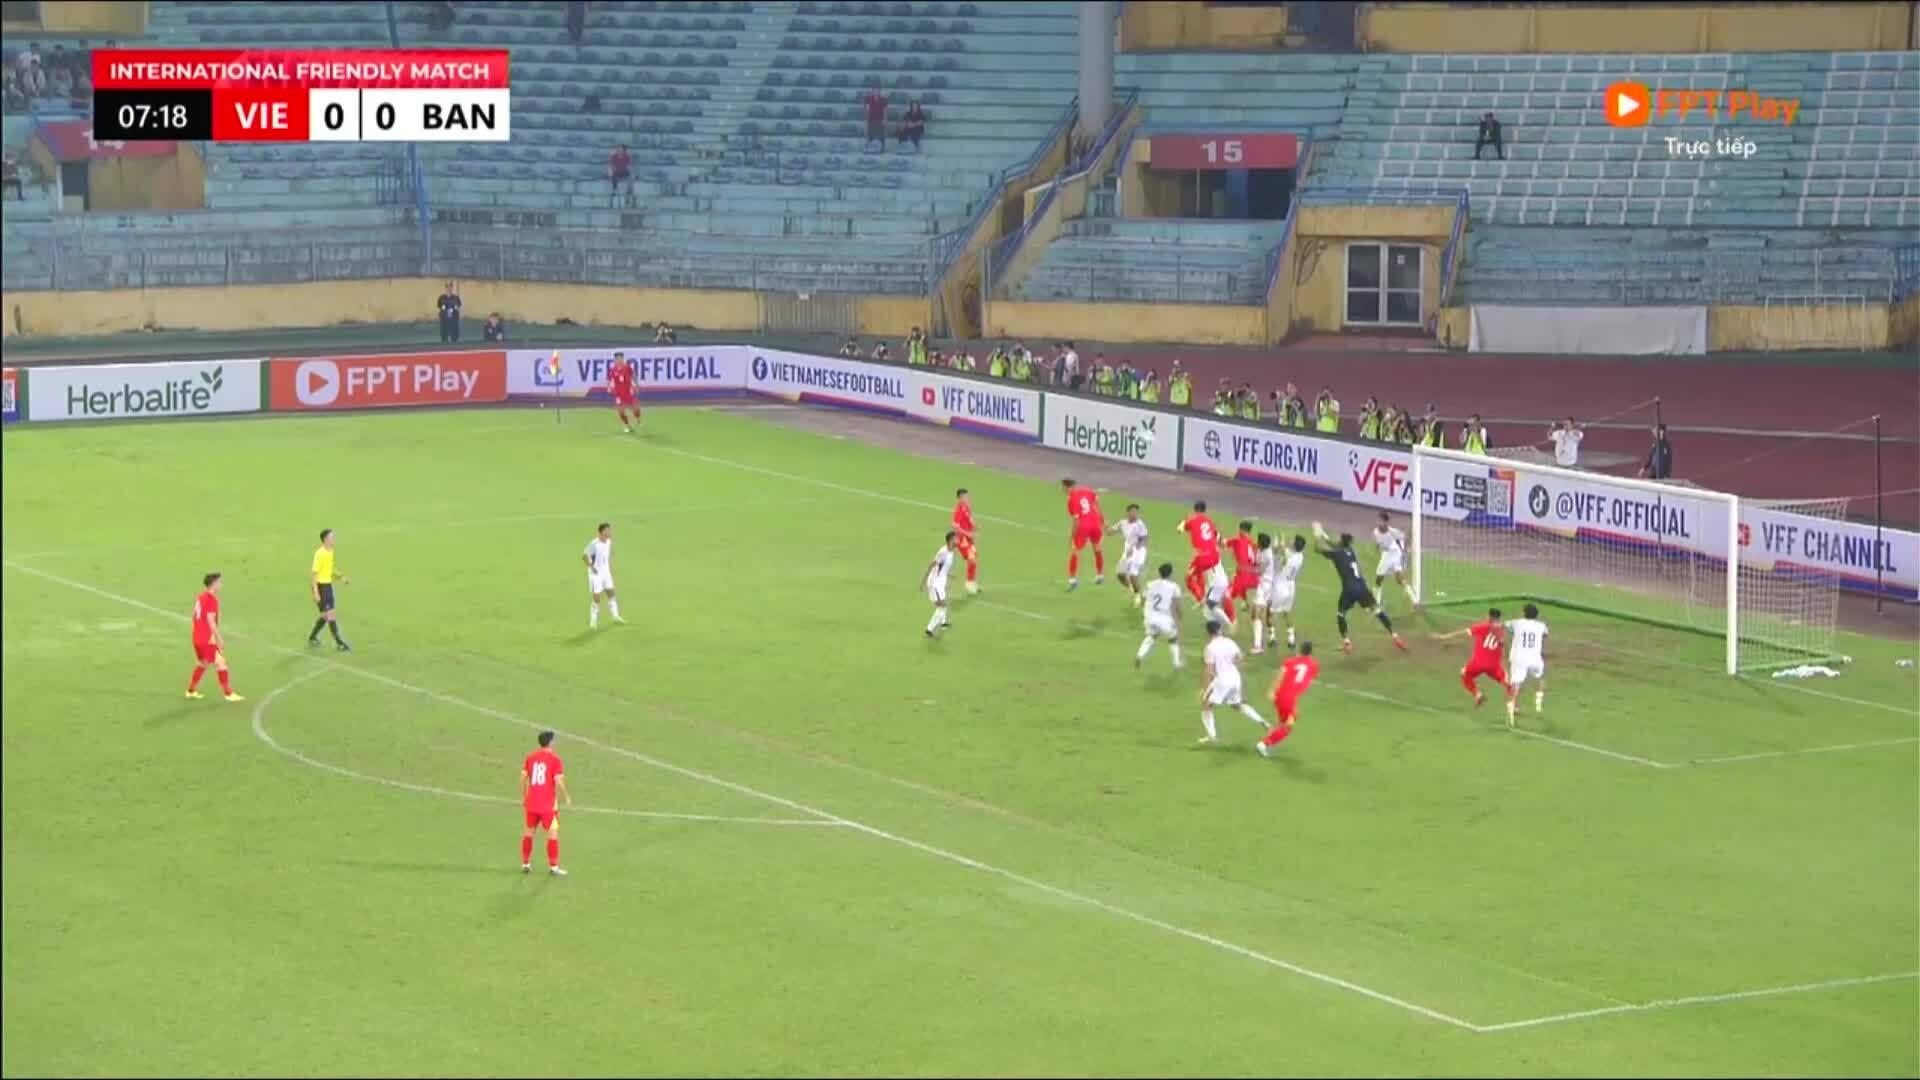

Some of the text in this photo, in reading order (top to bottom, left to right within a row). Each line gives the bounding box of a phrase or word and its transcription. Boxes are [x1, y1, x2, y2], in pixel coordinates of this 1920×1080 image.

[1201, 140, 1244, 163] 15
[67, 380, 210, 415] Herbalife
[346, 362, 480, 398] FPT Play
[770, 360, 905, 399] VIETNAMESEFOOTBALL
[941, 385, 1025, 423] VFF CHANNEL
[1063, 415, 1147, 459] Herbalife
[1231, 435, 1319, 475] VFF.ORG.VN
[1353, 458, 1409, 497] VFF
[1555, 490, 1691, 540] @VFF.OFFICIAL
[1762, 521, 1897, 573] VFF CHANNEL
[1152, 593, 1163, 611] 2
[531, 761, 548, 787] 18
